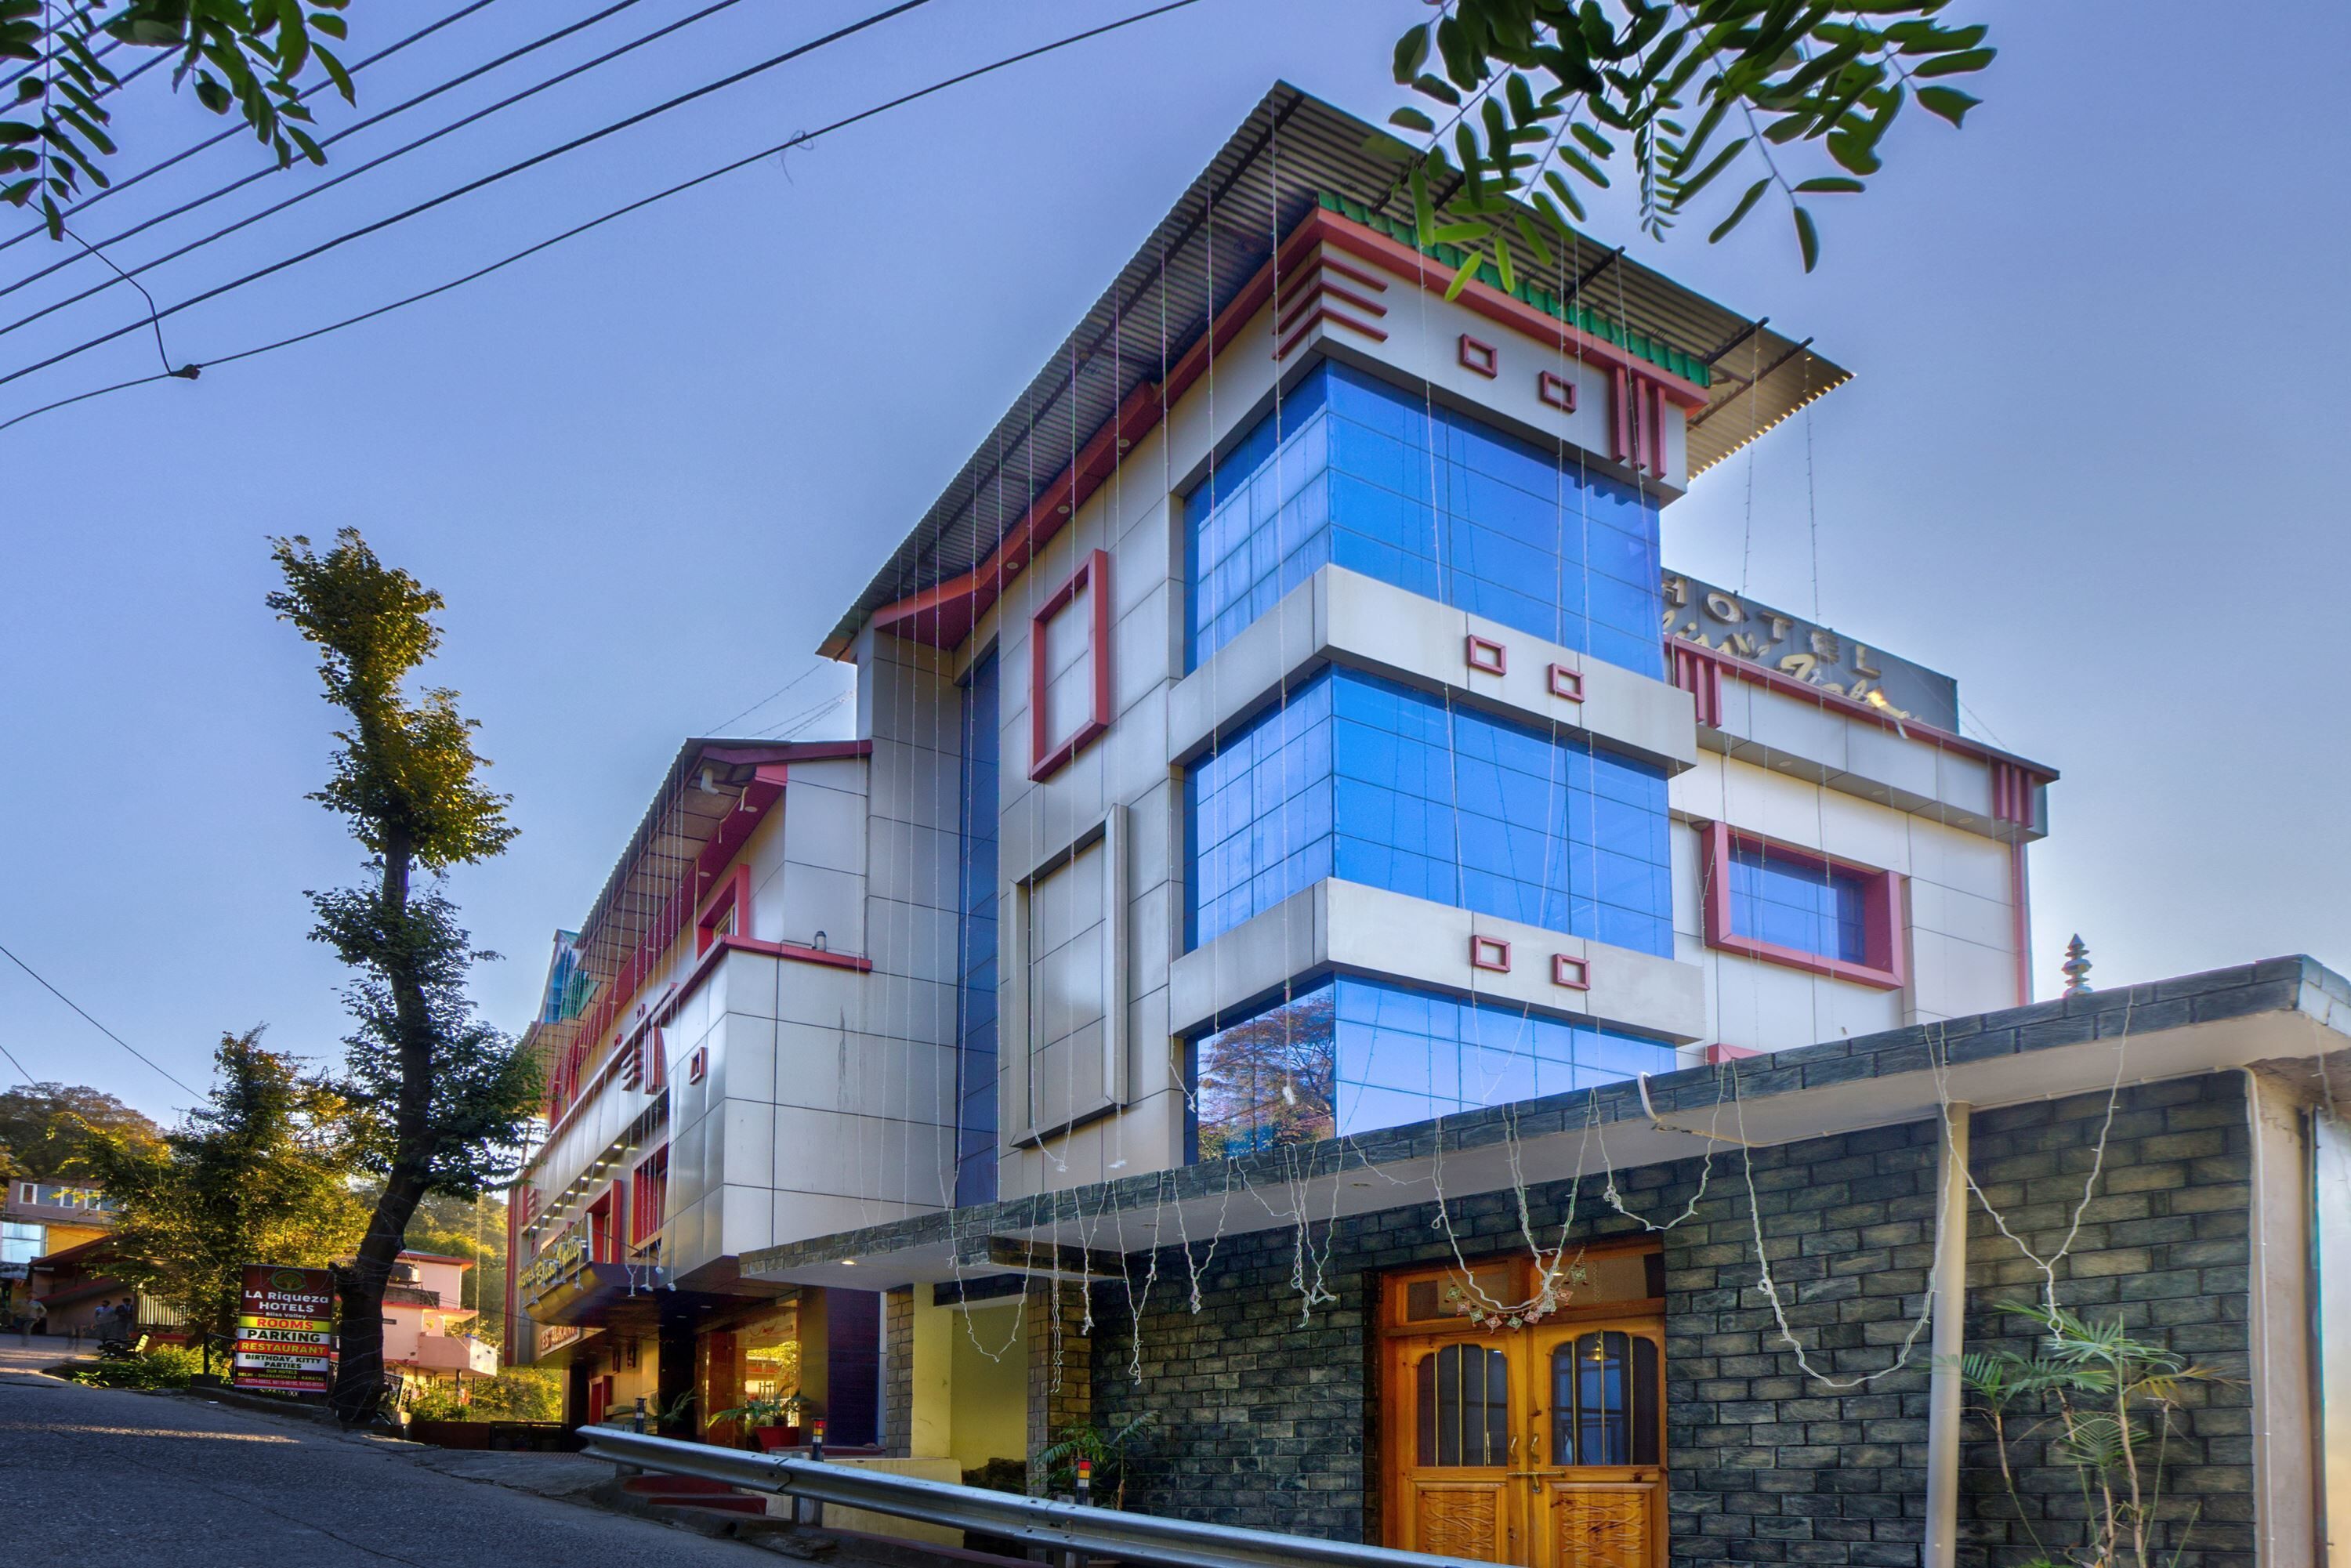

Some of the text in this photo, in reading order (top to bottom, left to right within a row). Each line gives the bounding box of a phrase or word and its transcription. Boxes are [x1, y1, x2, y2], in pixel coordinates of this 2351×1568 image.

[245, 1290, 329, 1304] LA Riqueza
[259, 1302, 314, 1313] HOTELS
[257, 1318, 313, 1330] ROOMS
[248, 1330, 321, 1342] PARKING
[241, 1342, 325, 1354] RESTAURANT
